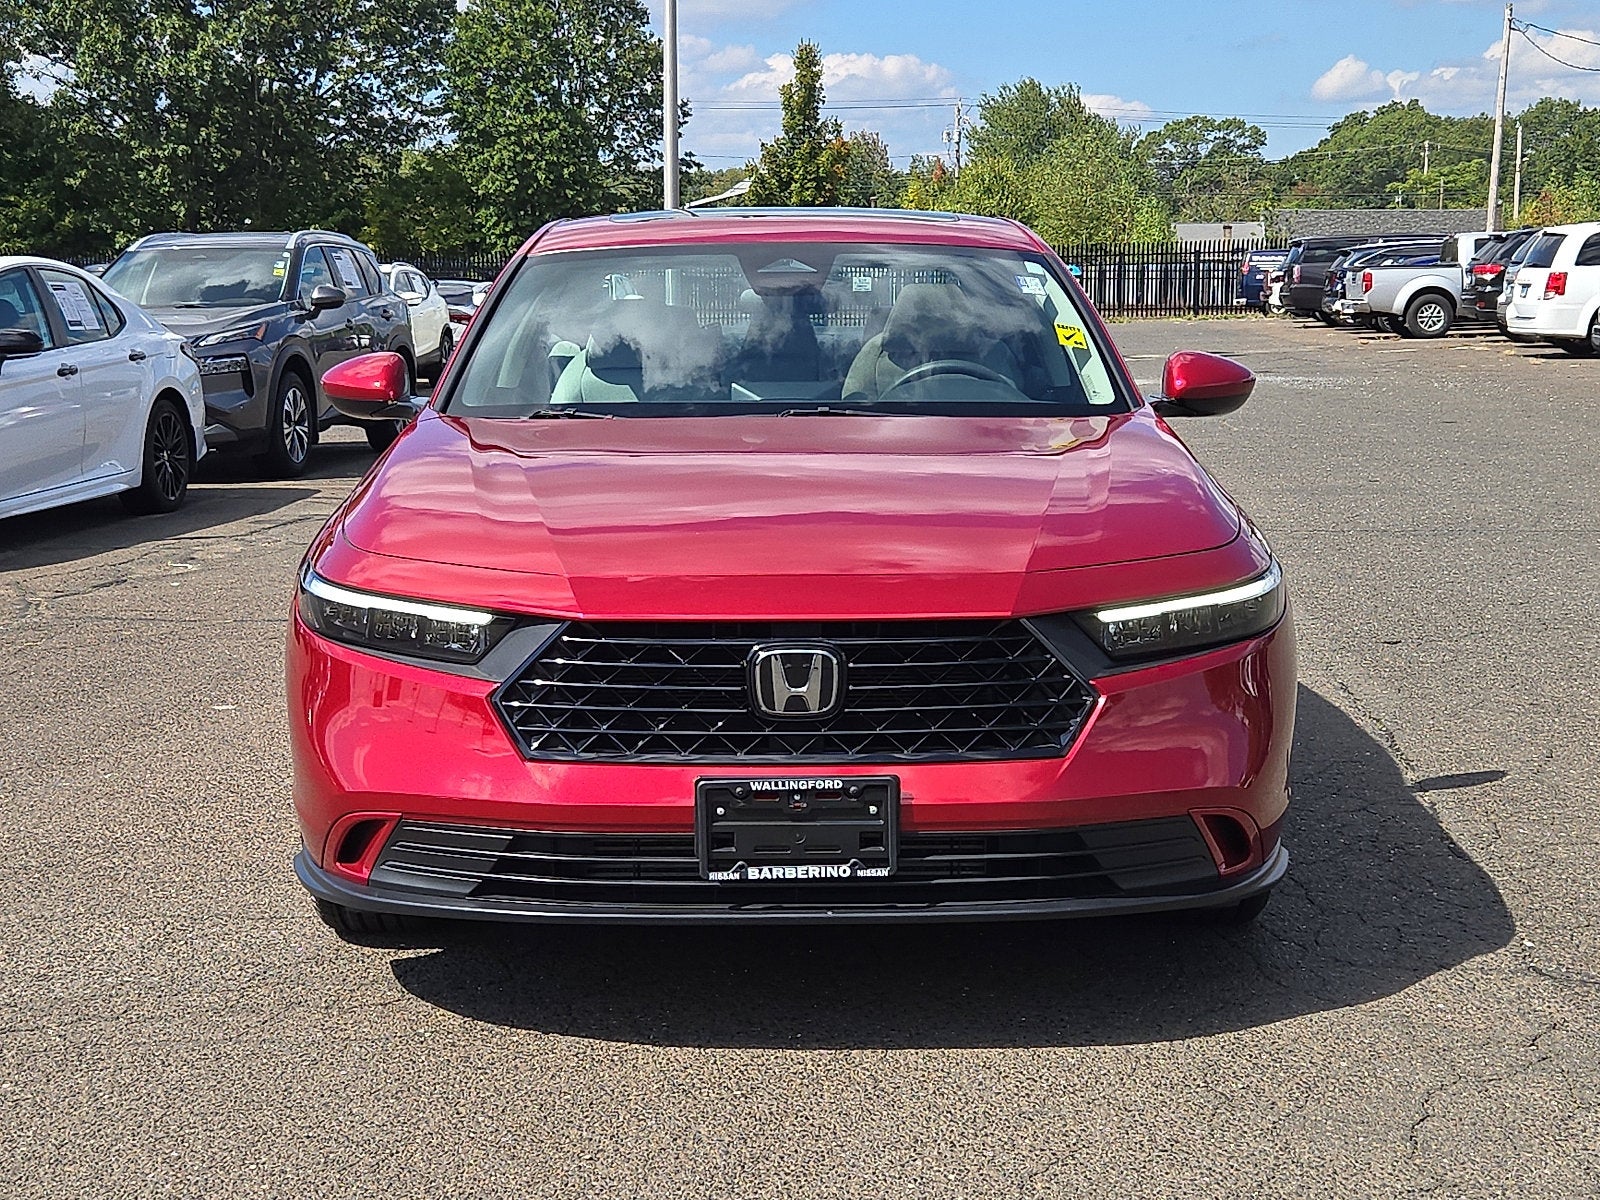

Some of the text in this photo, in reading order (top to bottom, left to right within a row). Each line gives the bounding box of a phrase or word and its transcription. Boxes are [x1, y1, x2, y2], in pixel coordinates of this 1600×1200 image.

[749, 780, 843, 791] WALLINGFORD
[708, 865, 890, 881] NISSAN BARBERINO NISSAN
